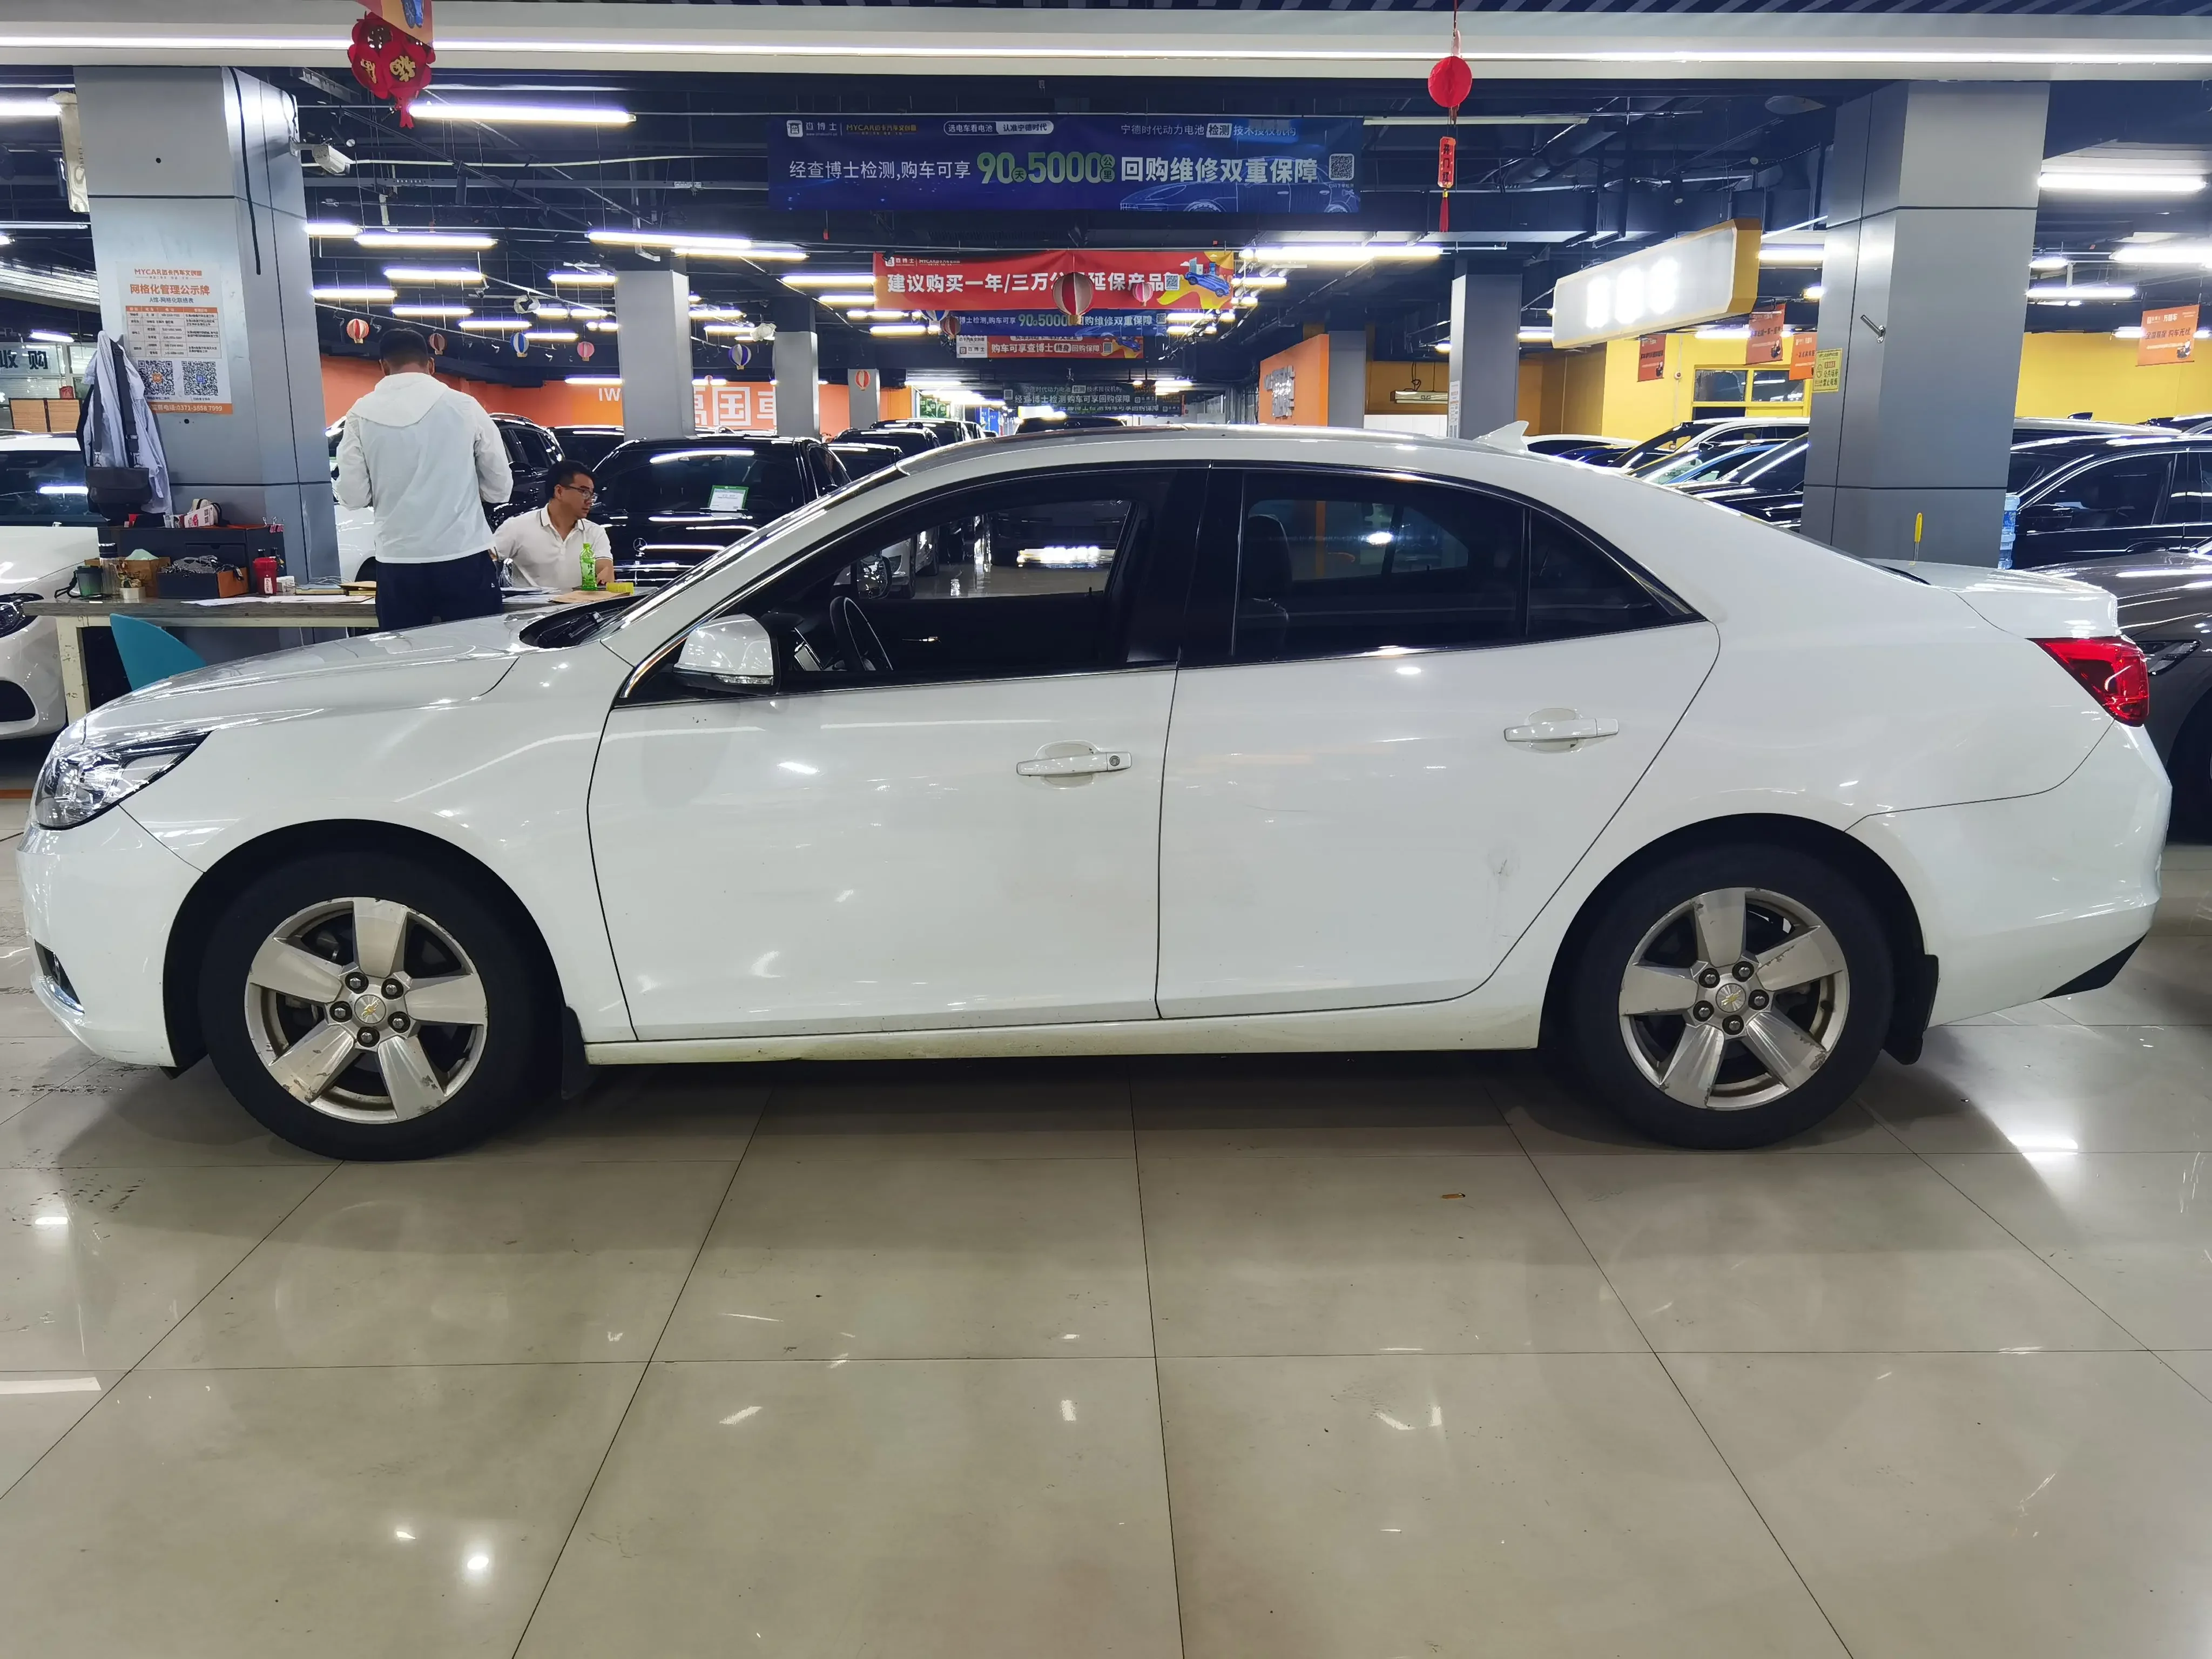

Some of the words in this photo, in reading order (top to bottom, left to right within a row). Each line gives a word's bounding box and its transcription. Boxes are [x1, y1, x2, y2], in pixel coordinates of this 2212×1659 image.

[948, 124, 993, 133] 选电车看电池
[1003, 123, 1047, 132] 认准宁德时代
[1121, 125, 1205, 136] 宁德时代动力电池
[1208, 124, 1231, 136] 检测
[1121, 156, 1318, 184] 回购维修双重保障
[130, 284, 210, 295] 网格化管理公示牌
[992, 343, 1053, 353] 购车可享查博士
